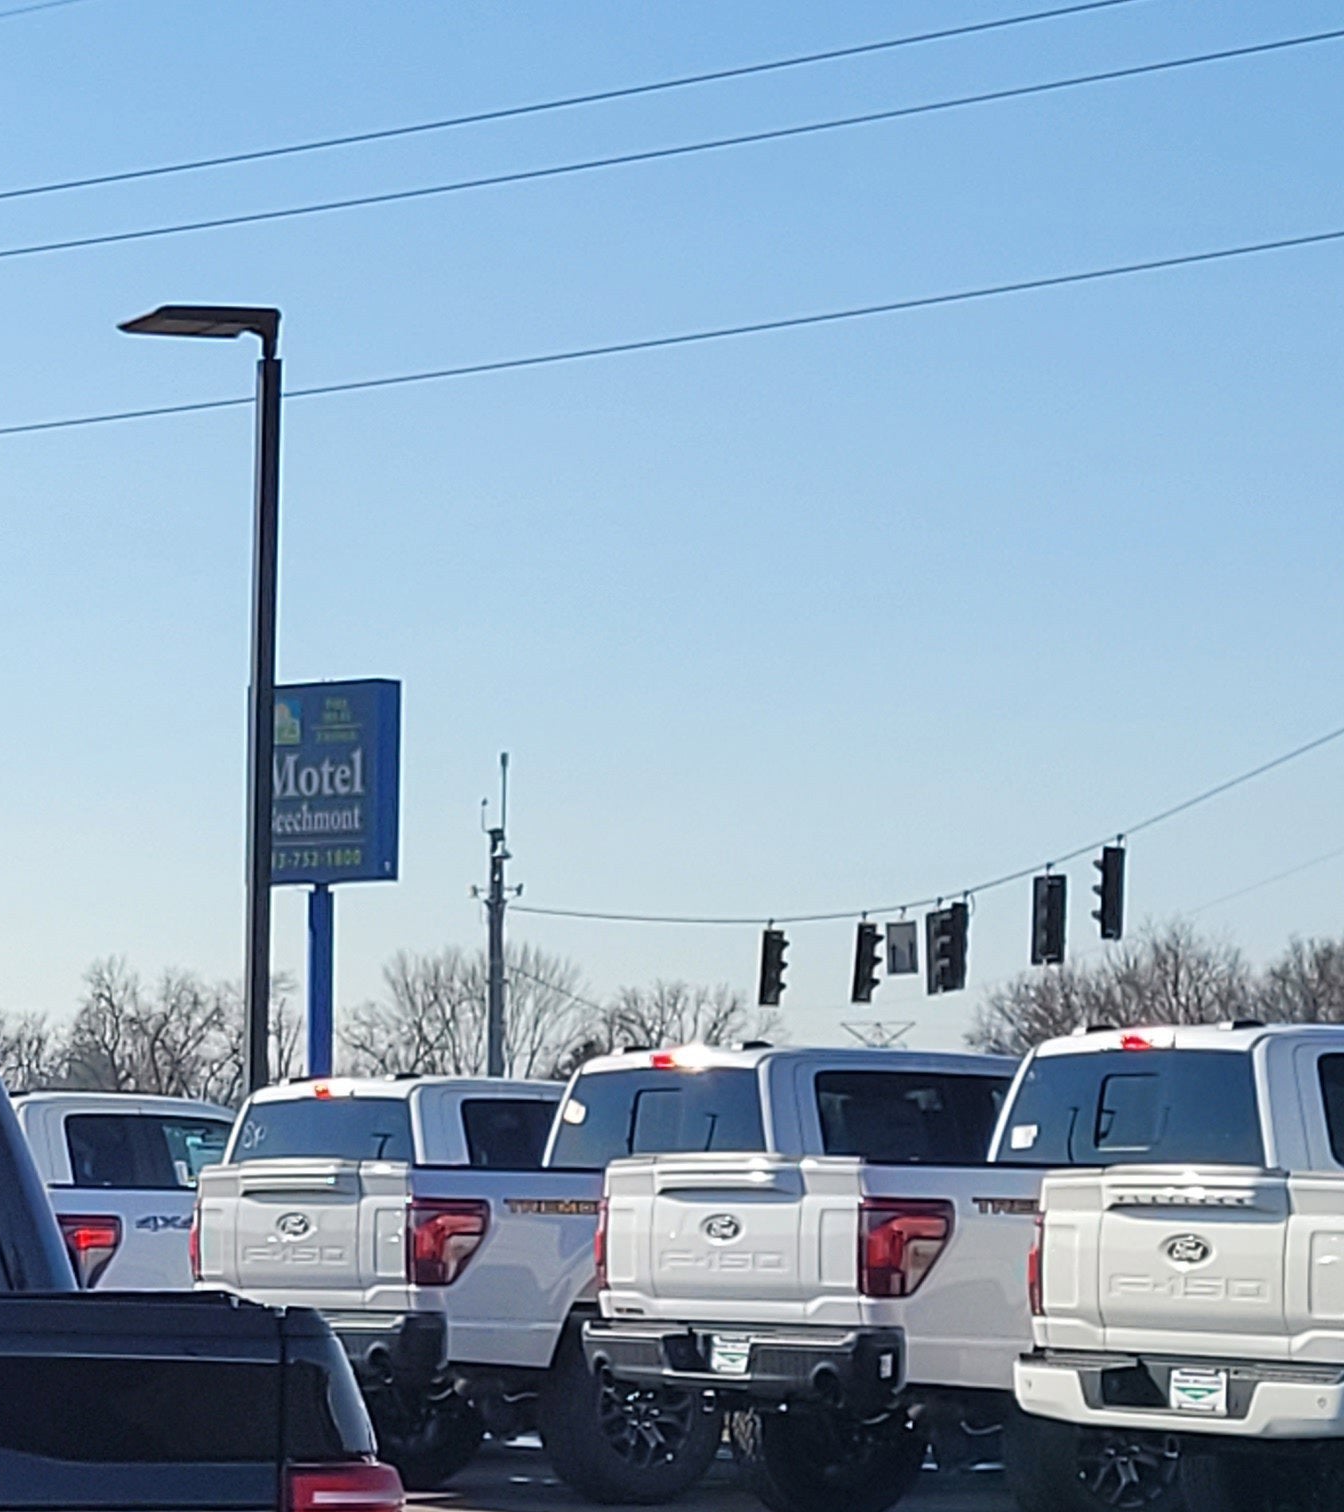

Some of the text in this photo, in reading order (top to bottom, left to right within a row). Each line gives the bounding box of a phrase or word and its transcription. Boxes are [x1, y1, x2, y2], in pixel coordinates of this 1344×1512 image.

[273, 748, 364, 797] Motel
[272, 803, 360, 833] eechmont
[658, 1249, 789, 1274] F-150
[1108, 1273, 1270, 1303] F-150
